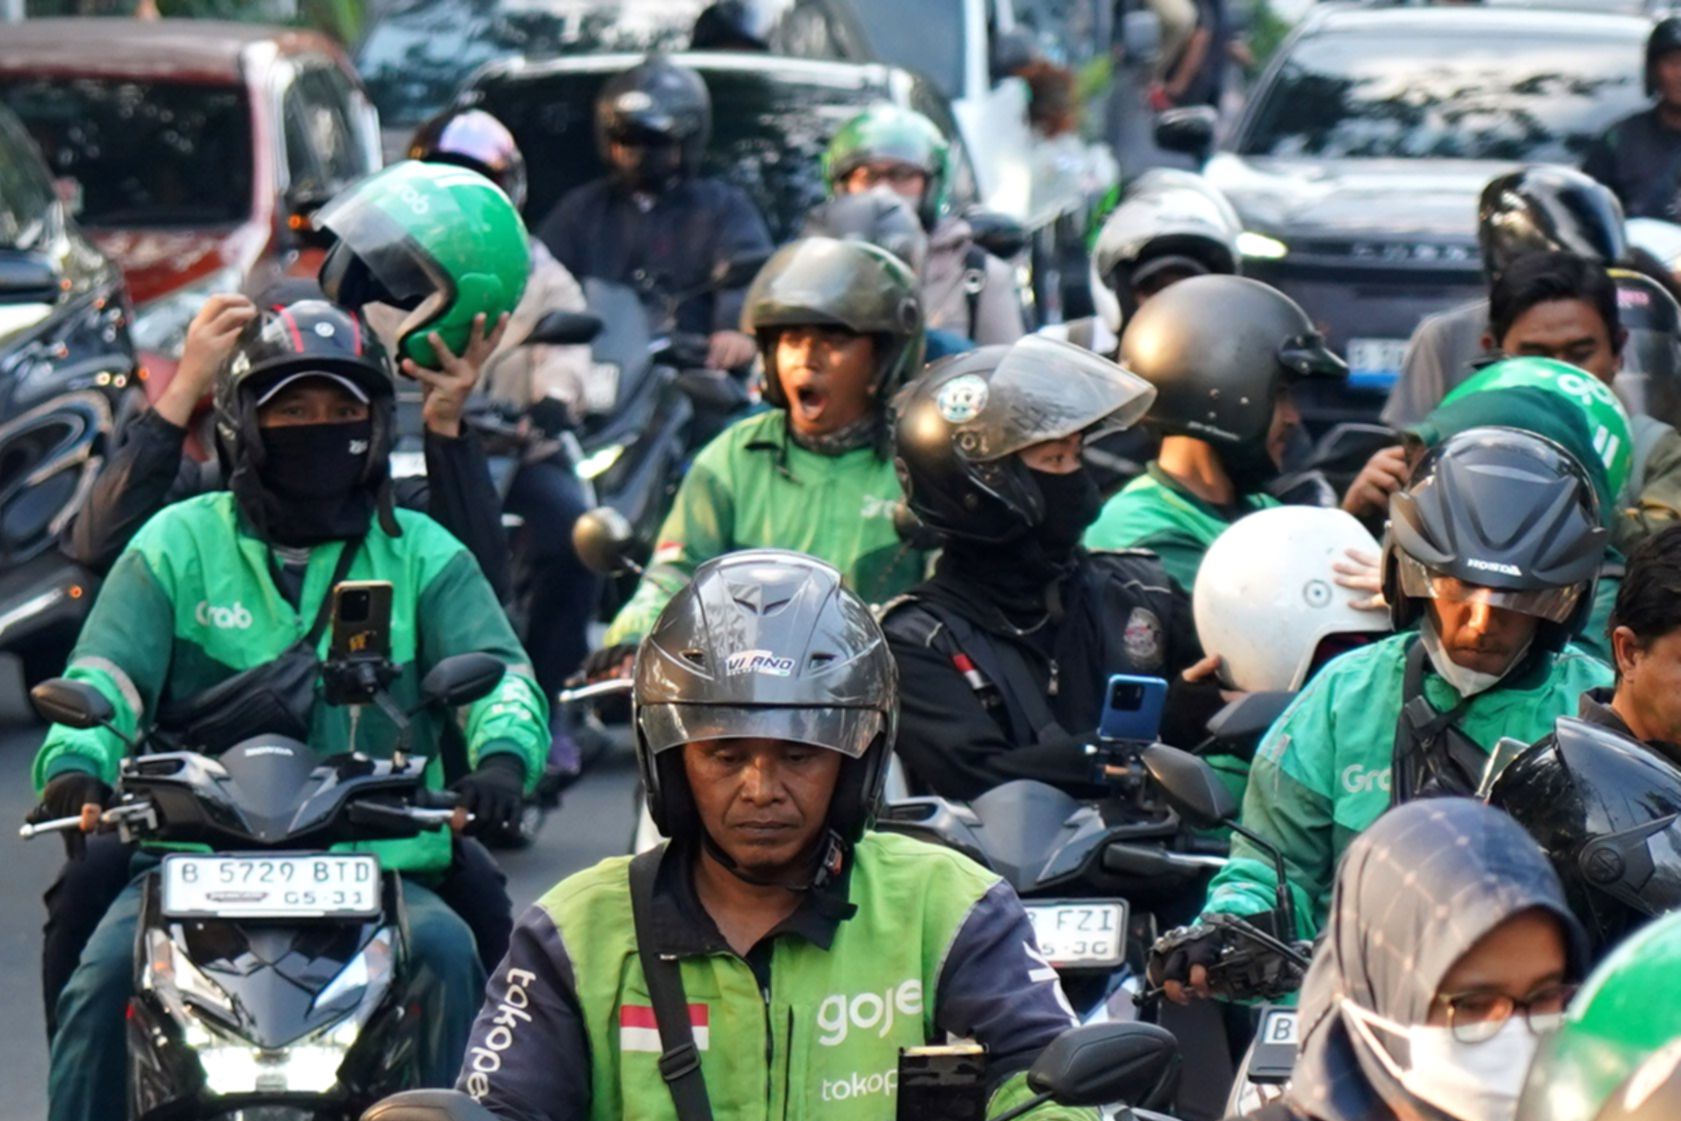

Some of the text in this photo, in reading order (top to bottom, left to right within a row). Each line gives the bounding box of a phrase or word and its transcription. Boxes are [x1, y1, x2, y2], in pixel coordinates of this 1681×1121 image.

[1467, 558, 1523, 577] HONDA
[182, 861, 369, 883] B 5729 BTD
[1056, 909, 1114, 934] FZI
[467, 967, 536, 1104] tokope
[1273, 1018, 1293, 1041] B
